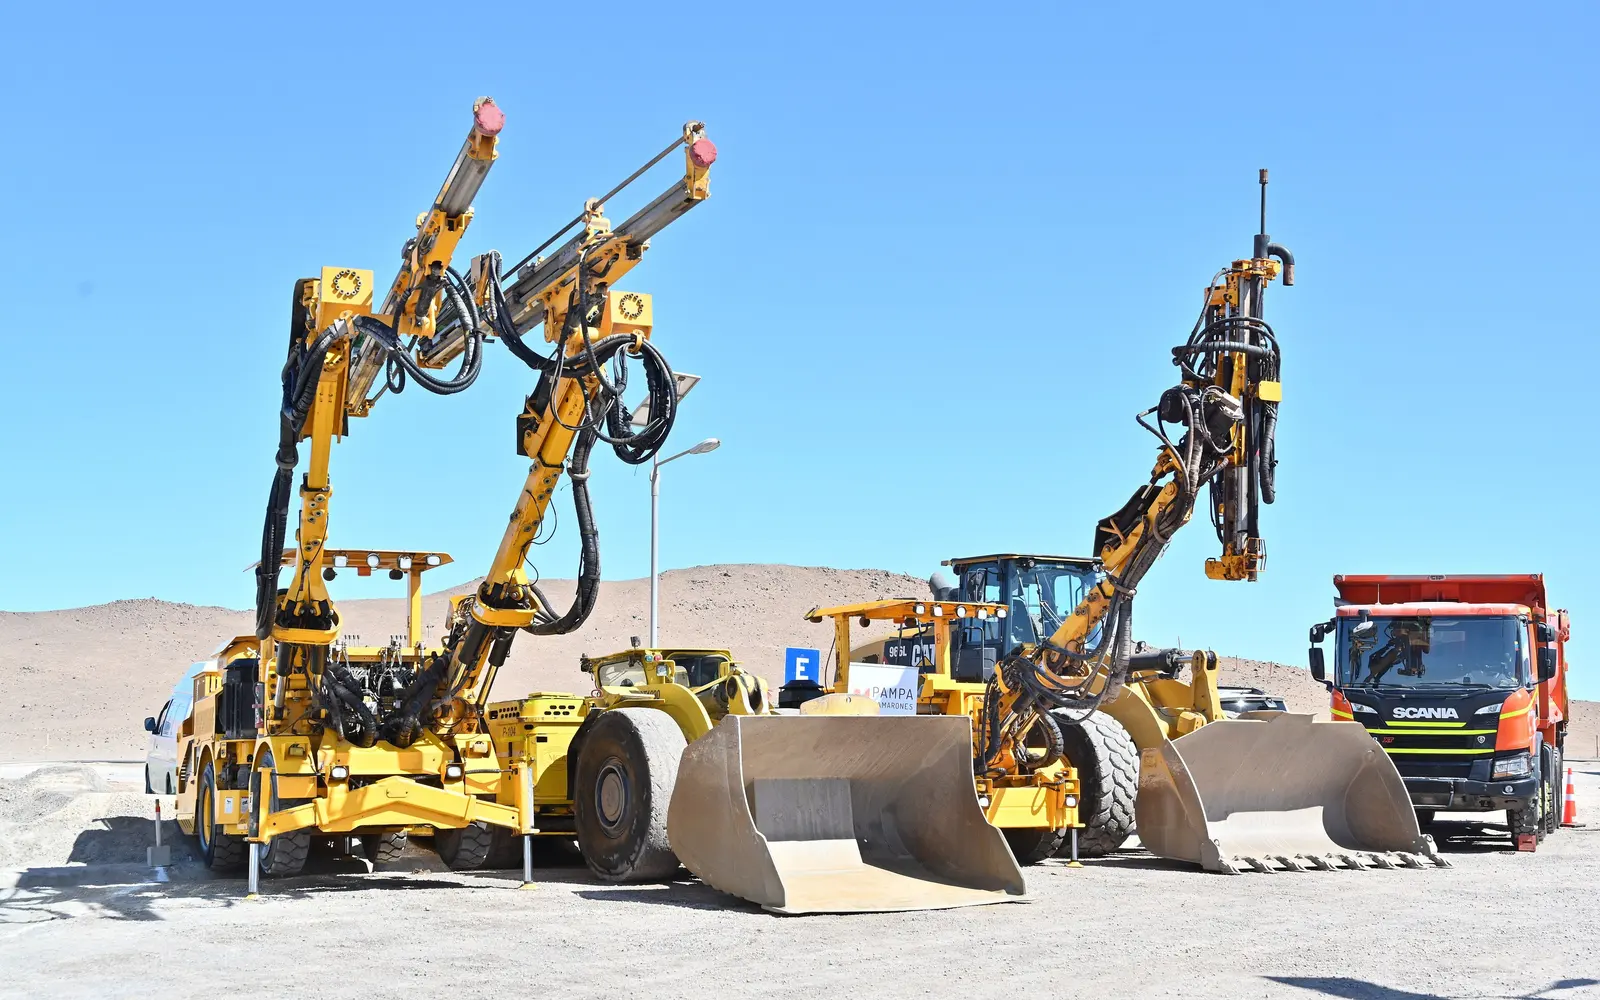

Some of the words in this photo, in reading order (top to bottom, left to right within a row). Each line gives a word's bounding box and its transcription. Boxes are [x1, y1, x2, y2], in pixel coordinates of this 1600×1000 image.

[889, 645, 907, 657] 966L
[911, 643, 936, 667] CAT
[795, 657, 810, 680] E
[872, 686, 914, 700] PAMPA
[878, 701, 914, 711] AMARONES
[1392, 707, 1459, 719] SCANIA
